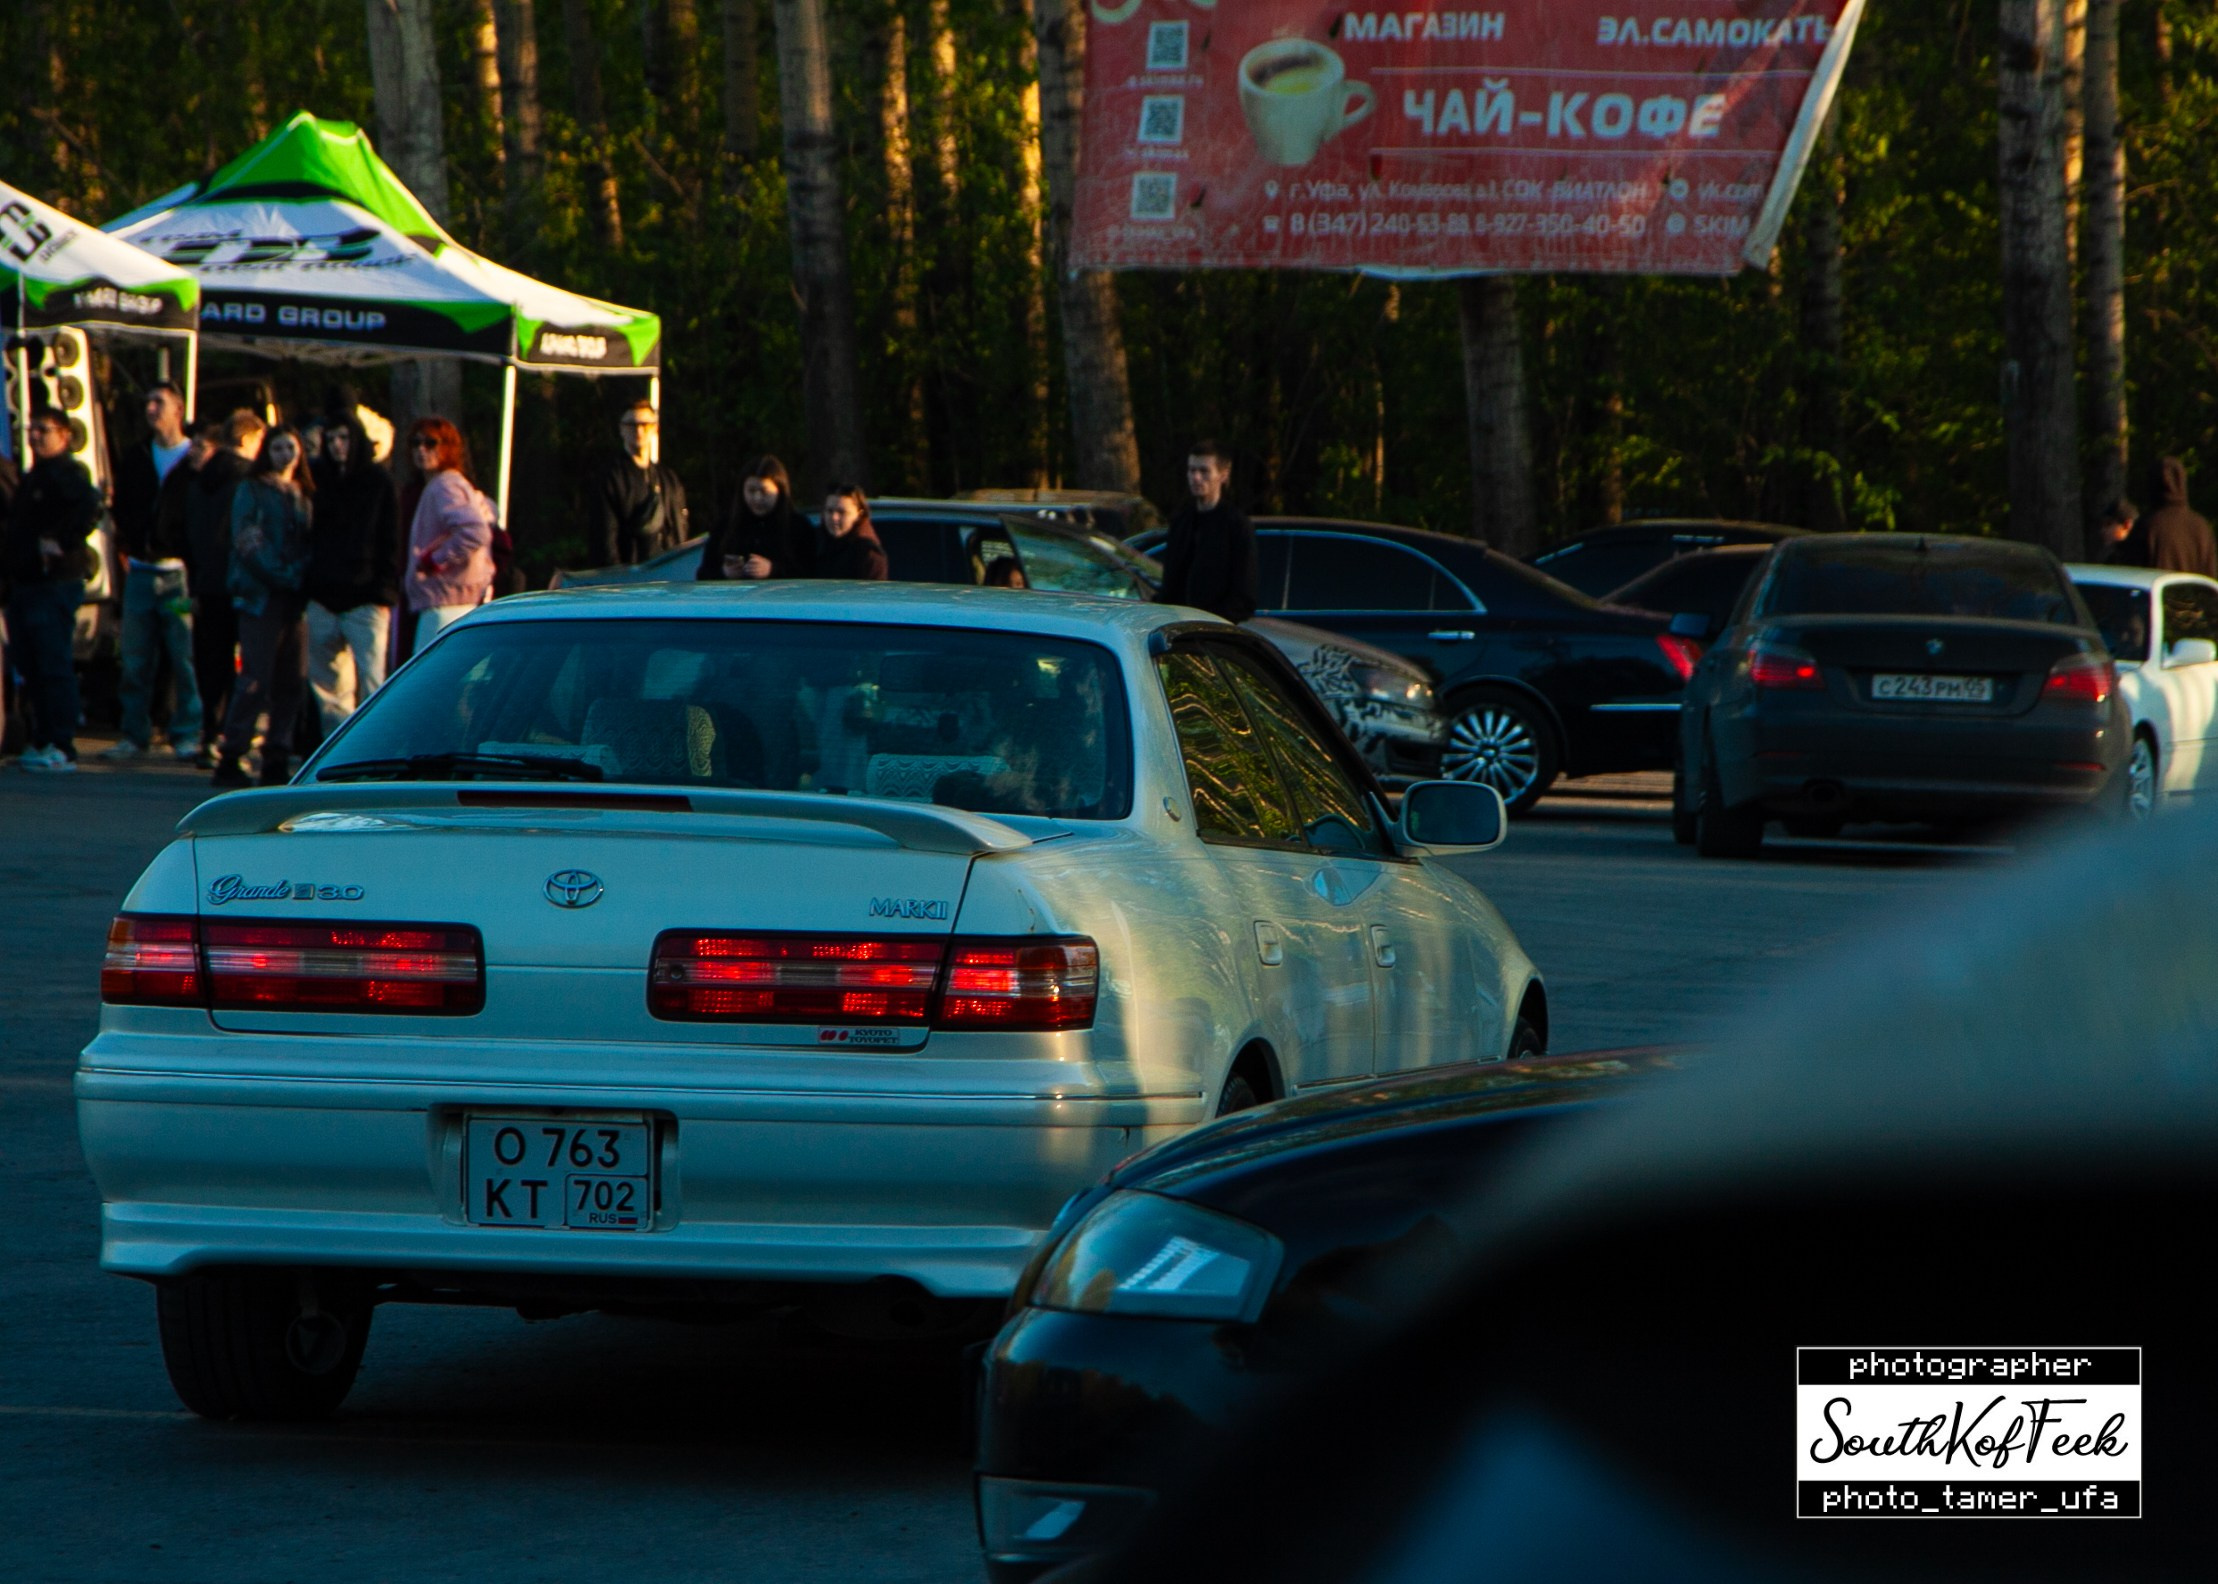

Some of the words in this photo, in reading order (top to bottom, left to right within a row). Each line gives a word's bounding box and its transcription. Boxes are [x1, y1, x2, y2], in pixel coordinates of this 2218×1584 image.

[1343, 11, 1504, 42] МАГАЗИН
[1402, 78, 1726, 138] ЧАЙ-КОФЕ
[1291, 213, 1305, 236] 8
[278, 304, 386, 331] GROUP
[208, 874, 290, 905] Grande
[855, 1029, 893, 1037] KYOTO
[542, 1128, 620, 1168] 763
[573, 1180, 634, 1212] 702
[589, 1212, 617, 1224] RUS
